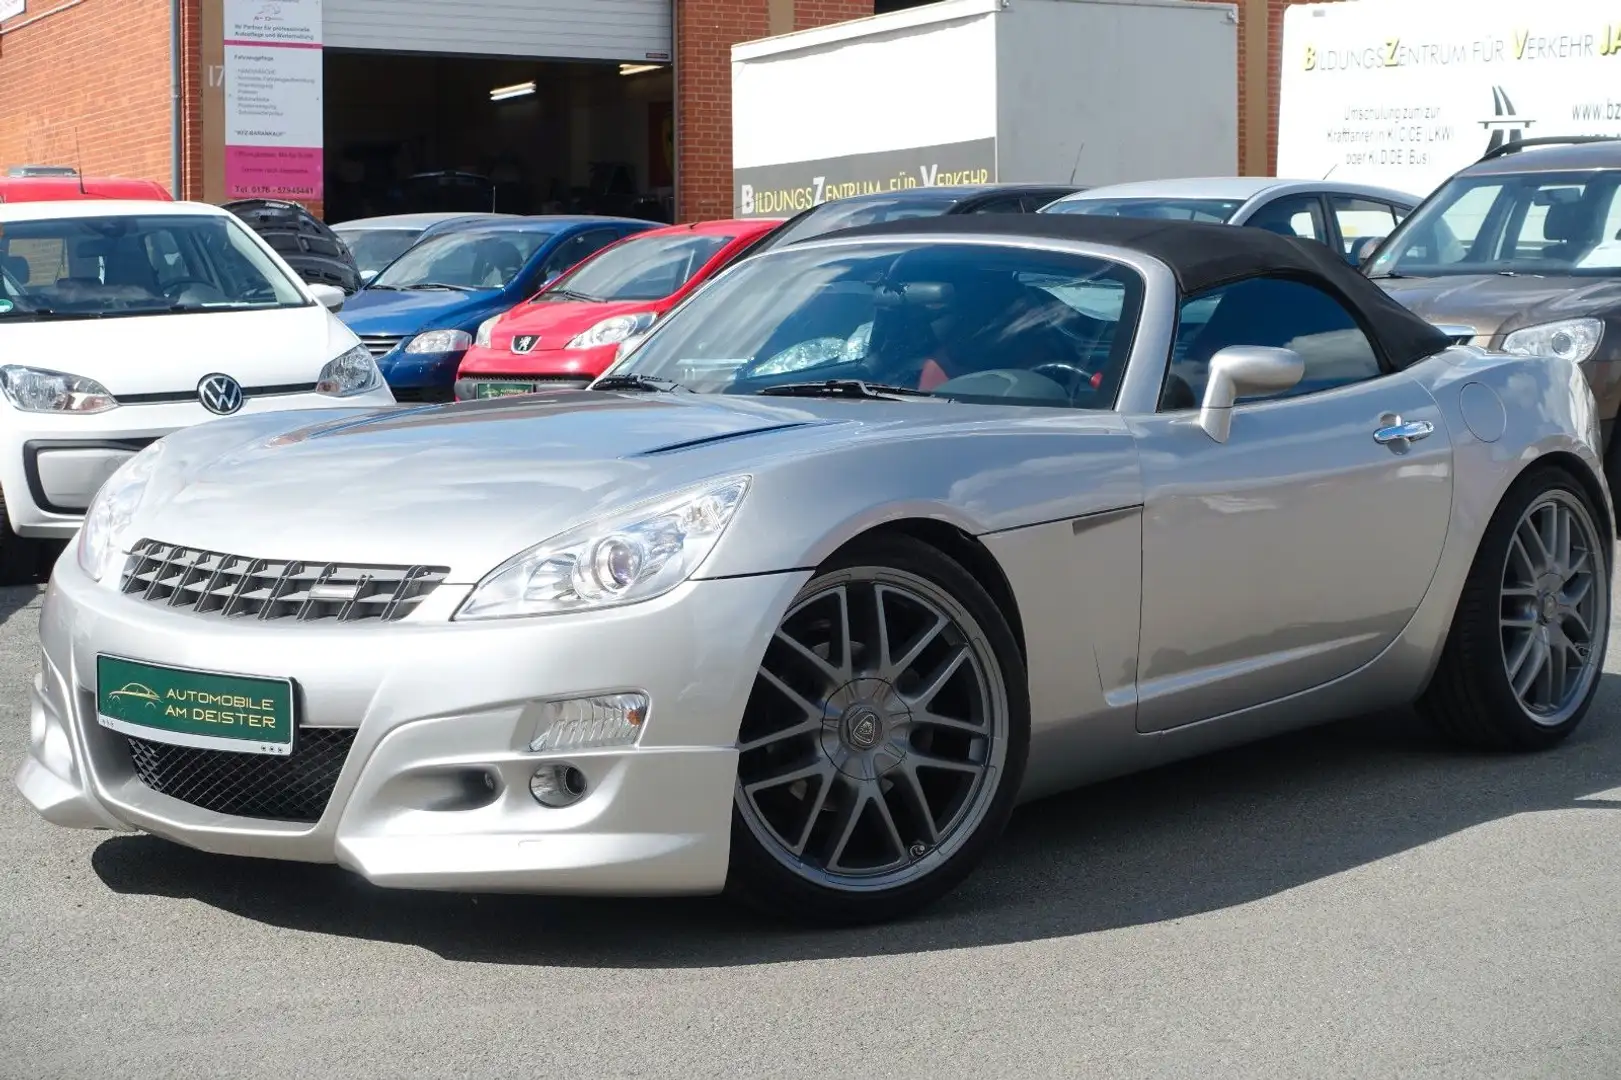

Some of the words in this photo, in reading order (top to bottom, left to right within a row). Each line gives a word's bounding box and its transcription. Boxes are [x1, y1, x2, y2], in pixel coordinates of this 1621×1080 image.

[1303, 37, 1466, 71] BILDUNGSZENTRUM
[1472, 35, 1504, 63] FÜR
[1512, 27, 1593, 60] VERKEHR
[166, 688, 274, 711] AUTOMOBILE
[165, 704, 187, 718] AM
[193, 708, 276, 729] DEISTER
